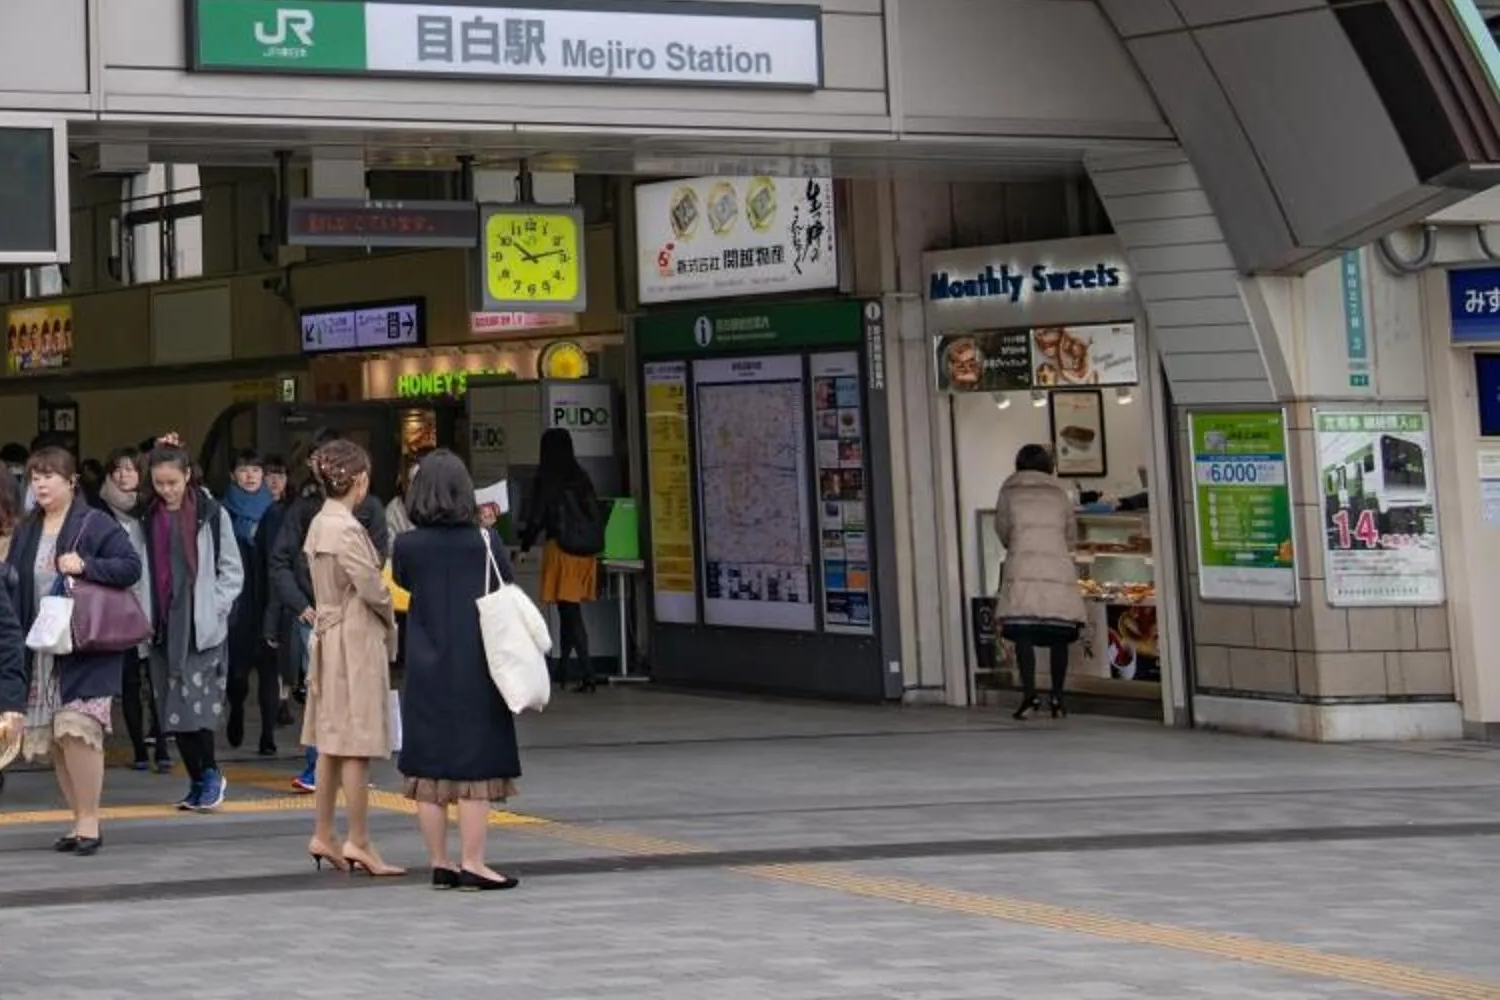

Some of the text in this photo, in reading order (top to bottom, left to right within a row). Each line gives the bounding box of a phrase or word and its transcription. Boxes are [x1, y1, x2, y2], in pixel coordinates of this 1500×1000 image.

[254, 8, 315, 46] JR
[416, 14, 773, 77] 目白駅 Mejiro Station
[930, 263, 1120, 303] Monthly Sweets
[397, 371, 468, 396] HONEY'S
[553, 407, 610, 426] PUDO
[1332, 509, 1379, 549] 14
